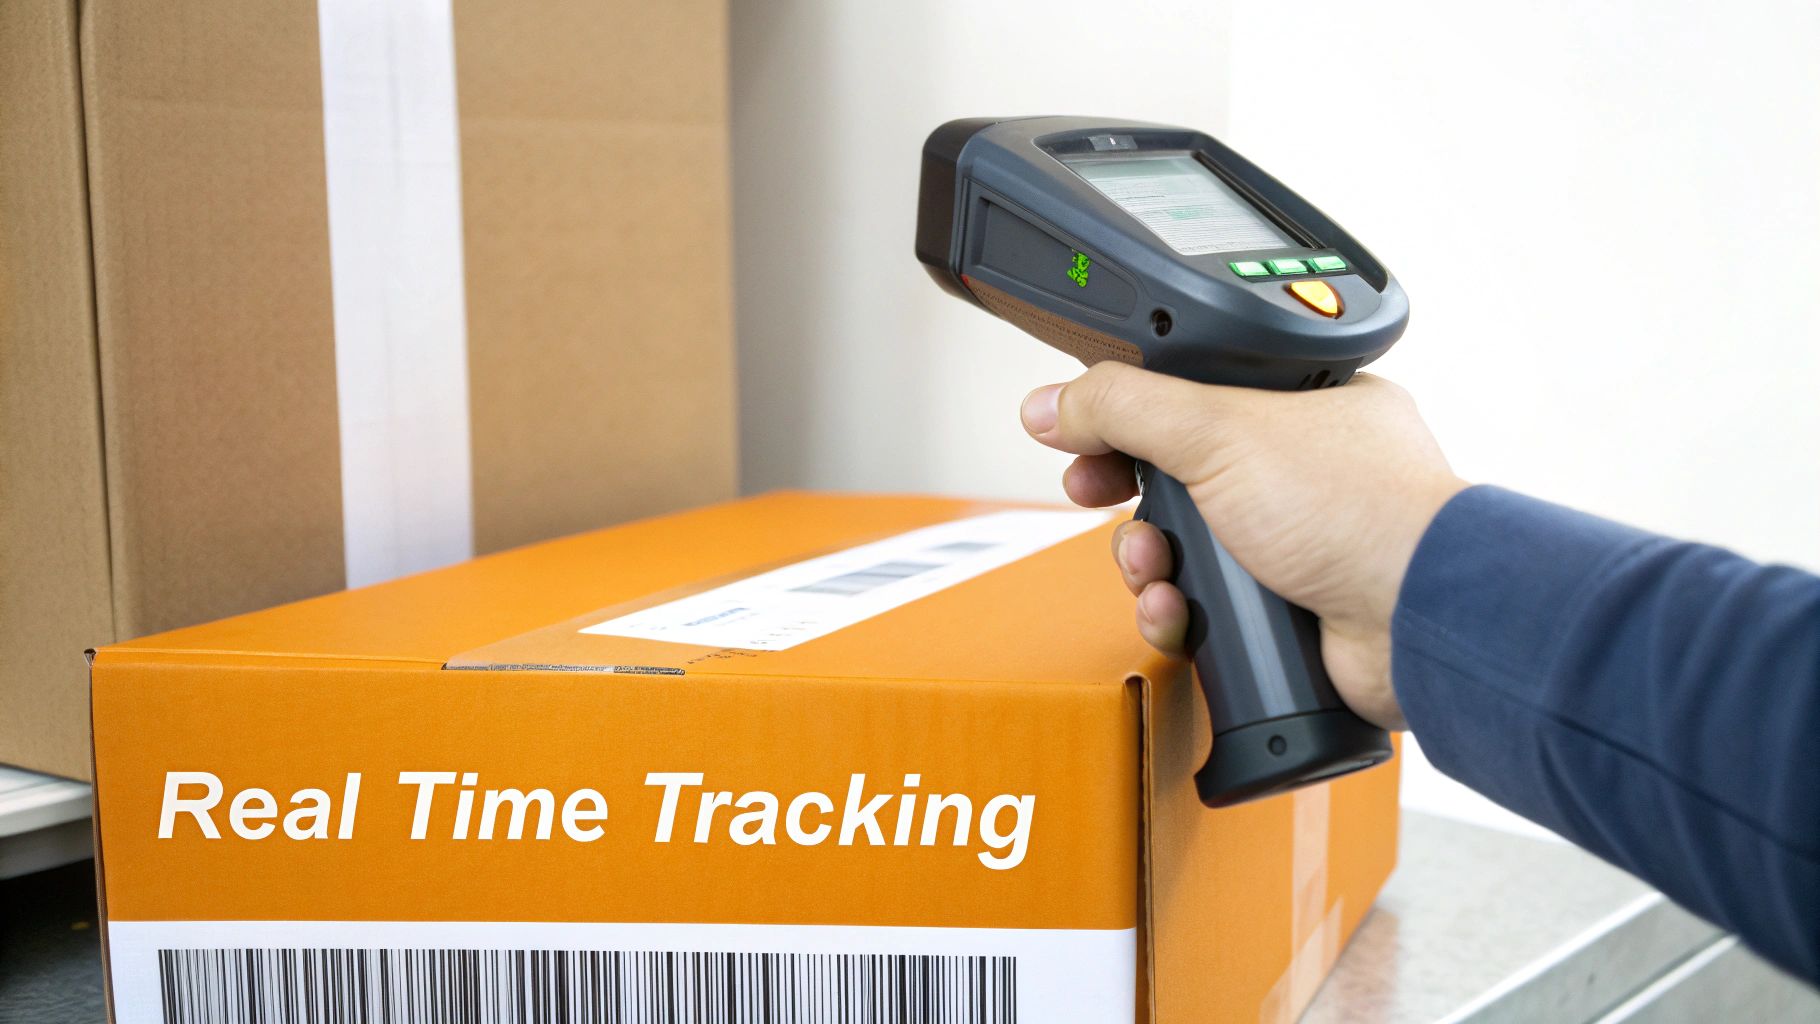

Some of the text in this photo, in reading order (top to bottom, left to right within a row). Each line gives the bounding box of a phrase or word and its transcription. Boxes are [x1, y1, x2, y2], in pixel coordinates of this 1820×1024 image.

[157, 770, 1036, 870] Real Time Tracking
